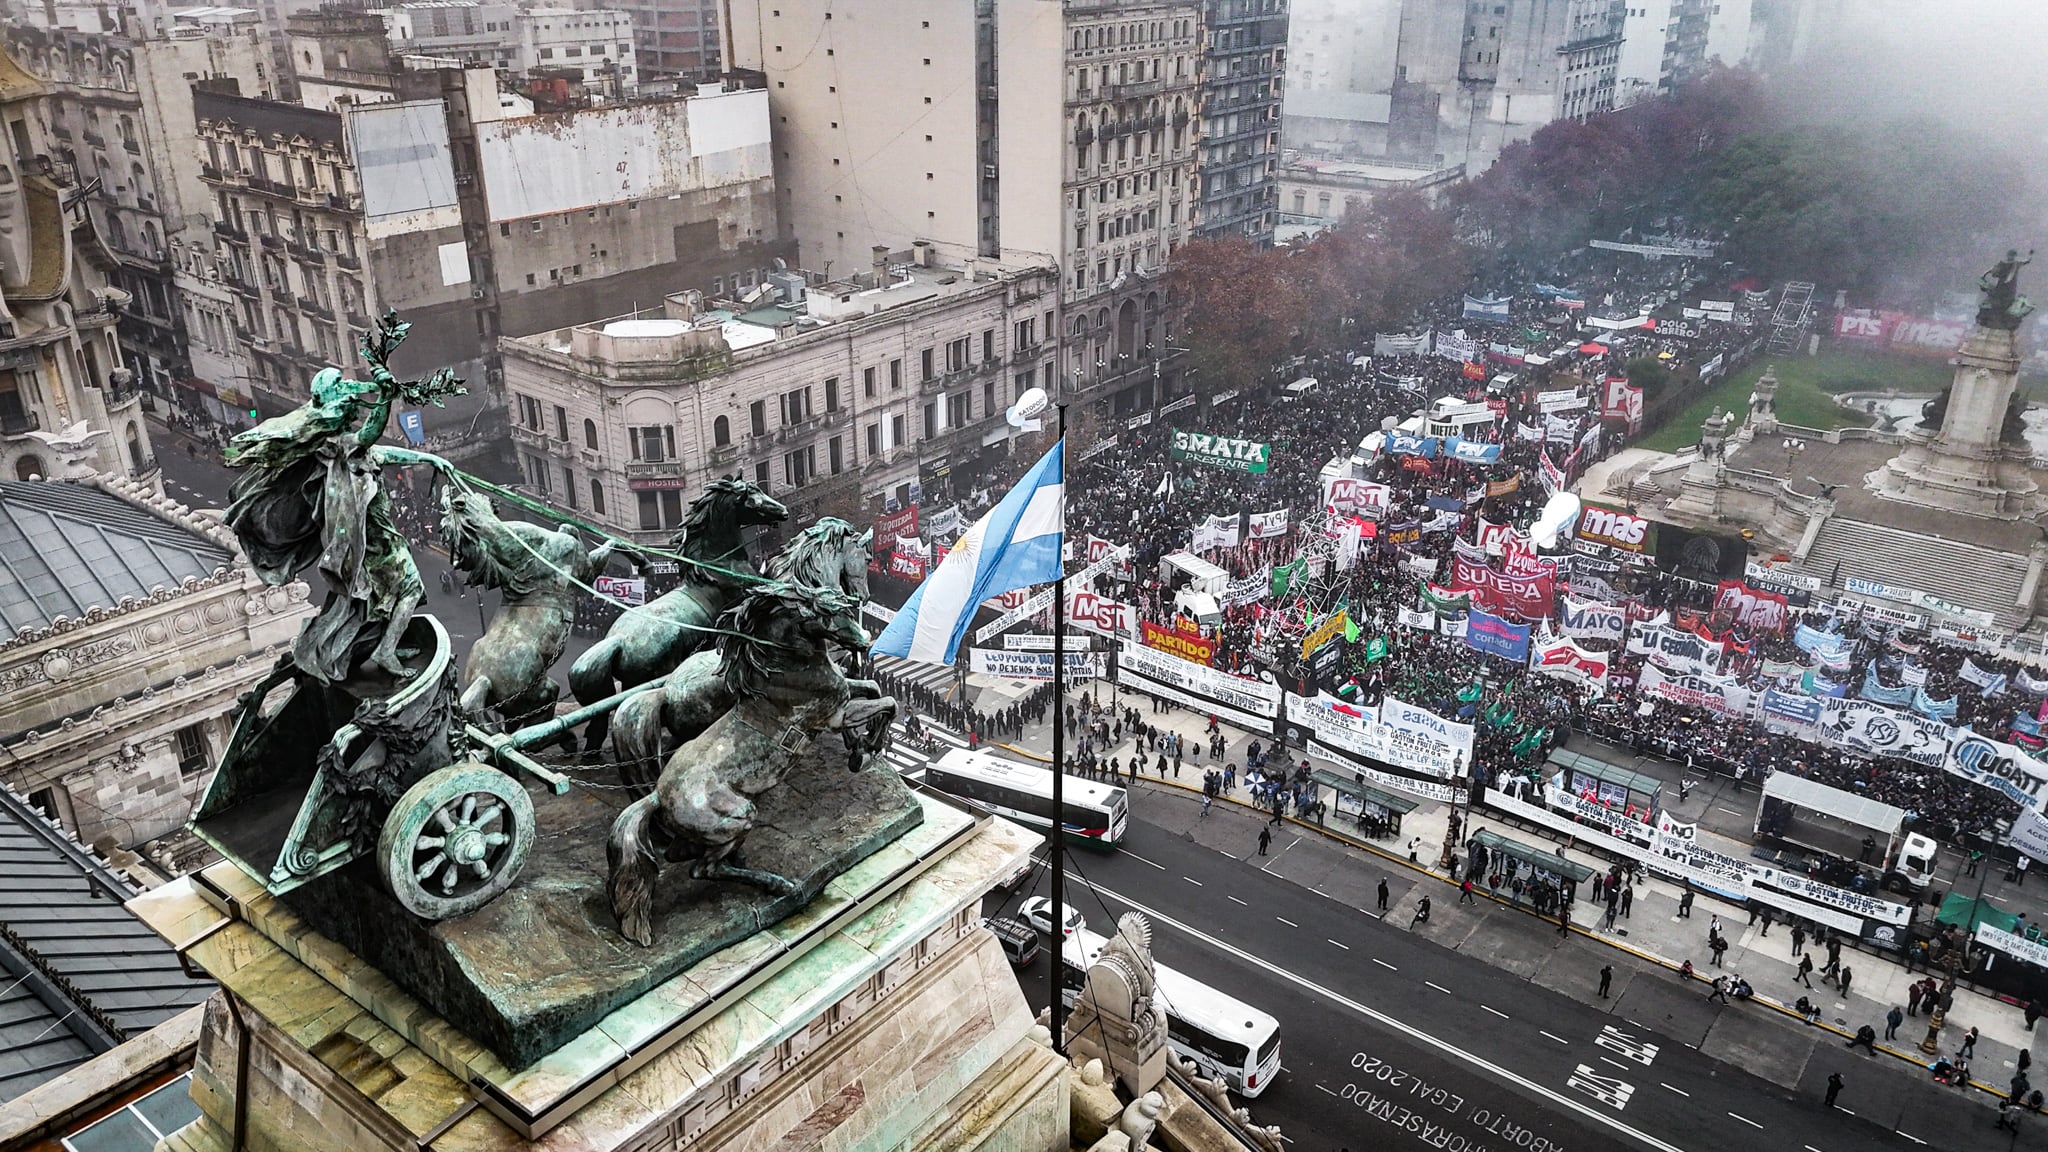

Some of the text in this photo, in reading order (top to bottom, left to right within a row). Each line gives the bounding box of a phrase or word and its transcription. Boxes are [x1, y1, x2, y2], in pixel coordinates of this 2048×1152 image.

[1654, 326, 1694, 337] OBRERO
[1660, 319, 1688, 328] POLO
[1840, 317, 1882, 335] PTS
[406, 414, 418, 429] E
[1175, 432, 1264, 462] SMATA
[1185, 452, 1251, 470] PRESENTE
[648, 479, 681, 487] HOSTEL
[1335, 483, 1380, 506] MST
[1592, 509, 1648, 544] mas
[599, 580, 632, 596] MST
[1457, 564, 1541, 598] SUTEPA
[1760, 581, 1795, 596] SUTEP
[1002, 590, 1024, 608] ST
[1077, 598, 1126, 630] MST
[1562, 604, 1623, 631] MAYO
[1177, 616, 1198, 633] UJS
[1943, 620, 1976, 633] DERROTAR
[1147, 629, 1210, 659] PARTIDO
[1474, 632, 1513, 650] conadu
[1981, 634, 1997, 642] DNU
[985, 653, 1086, 666] LEOPOLDO MOEAU
[987, 664, 997, 672] NO
[999, 664, 1033, 674] DEJEMOS
[1659, 681, 1672, 692] EN
[1714, 695, 1726, 706] DE
[1827, 698, 1947, 741] JUVENTUD SINDICAL
[1820, 722, 1844, 742] TODOS
[1576, 802, 1632, 830] GASTON FRUTOS
[1671, 823, 1694, 839] NO
[1684, 843, 1714, 861] GASTON
[1714, 853, 1747, 871] FRUTOS
[1805, 884, 1838, 900] GASTON
[1841, 895, 1874, 910] FRUTOS
[1808, 892, 1875, 916] PANADEROS
[1351, 1052, 1408, 1087] 2020
[1566, 1063, 1636, 1111] BUS
